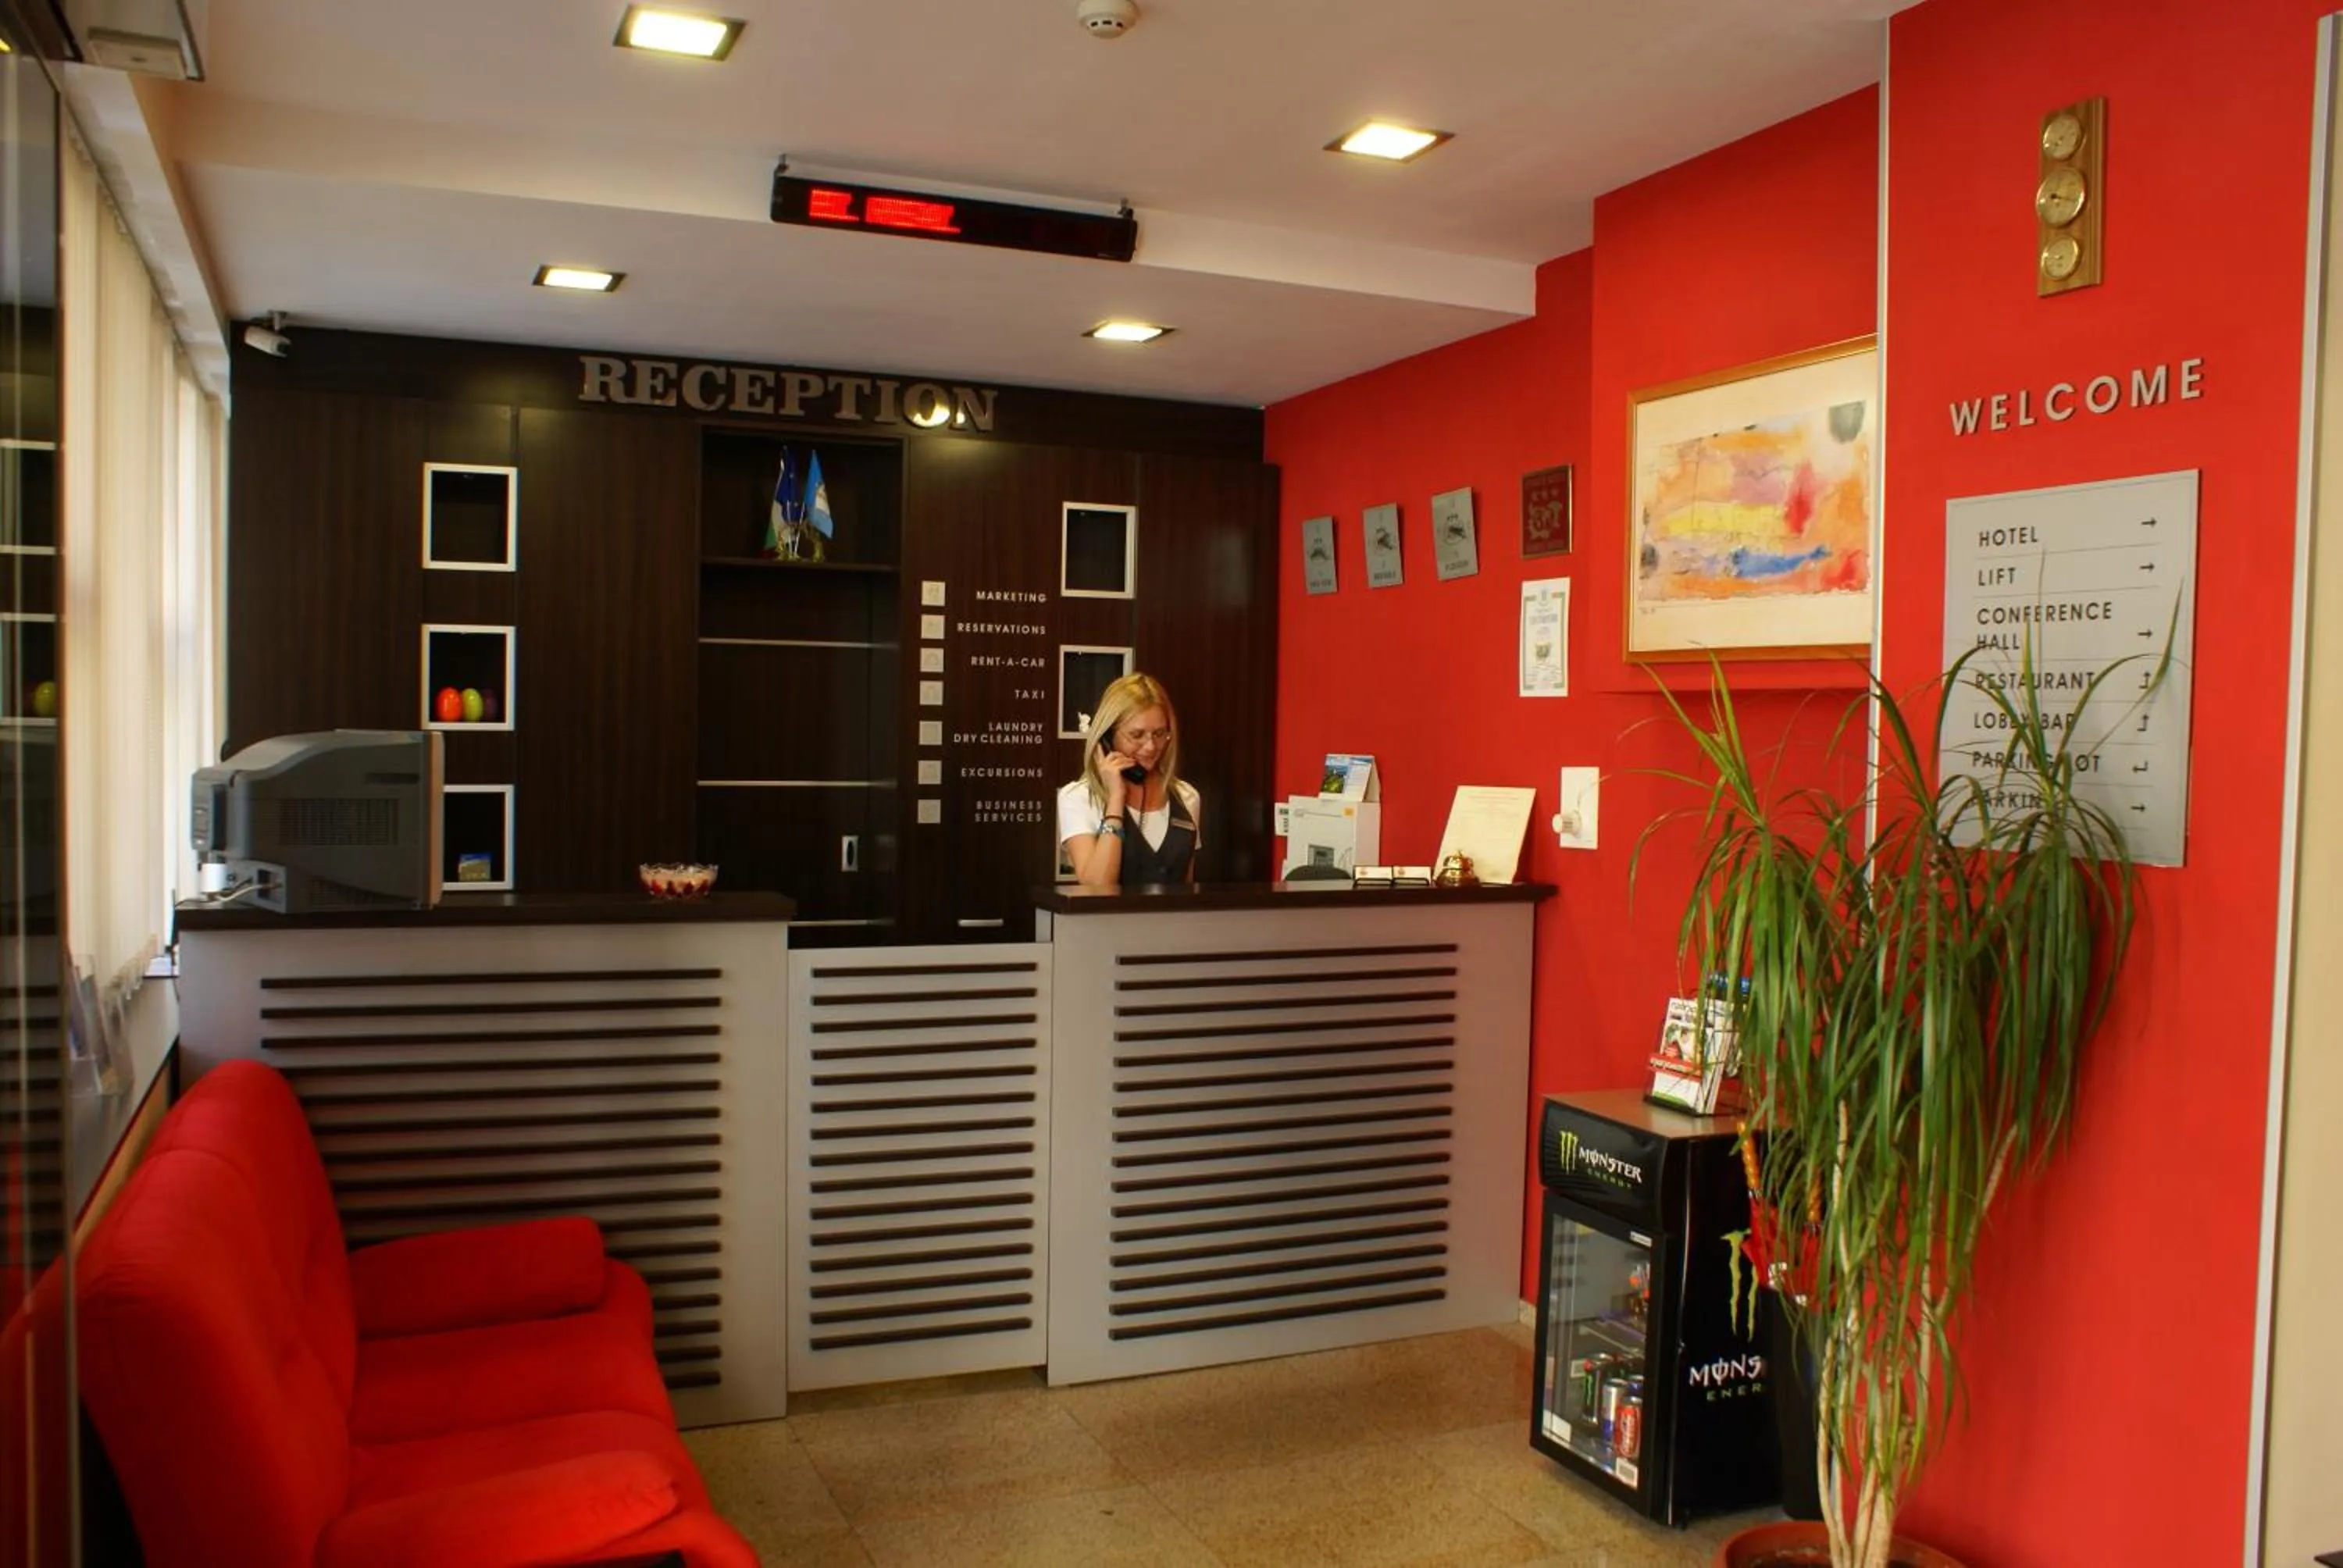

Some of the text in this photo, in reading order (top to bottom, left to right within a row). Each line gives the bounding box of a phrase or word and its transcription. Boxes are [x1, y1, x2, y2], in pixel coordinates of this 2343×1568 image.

[579, 355, 998, 432] RECEPTION
[1950, 357, 2204, 436] WELCOME
[1978, 526, 2038, 547] HOTEL
[1978, 568, 2017, 586] LIFT
[976, 590, 1047, 603] MARKETING
[1977, 601, 2113, 625] CONFERENCE
[957, 622, 1047, 635] RESERVATIONS
[1976, 633, 2021, 650] HALL
[971, 656, 1046, 668] RENT-A-CAR
[1015, 690, 1045, 700] TAXI
[988, 722, 1043, 732] LAUNDRY
[1974, 712, 2031, 729] LOBY
[954, 733, 1043, 744] DRY CLEANING
[2073, 754, 2101, 772] OT
[961, 768, 1043, 778] EXCURSIONS
[976, 800, 1043, 811] BUSINESS
[975, 813, 1043, 822] SERVICES
[1689, 1353, 1762, 1387] MONS
[1706, 1383, 1762, 1401] ENER
